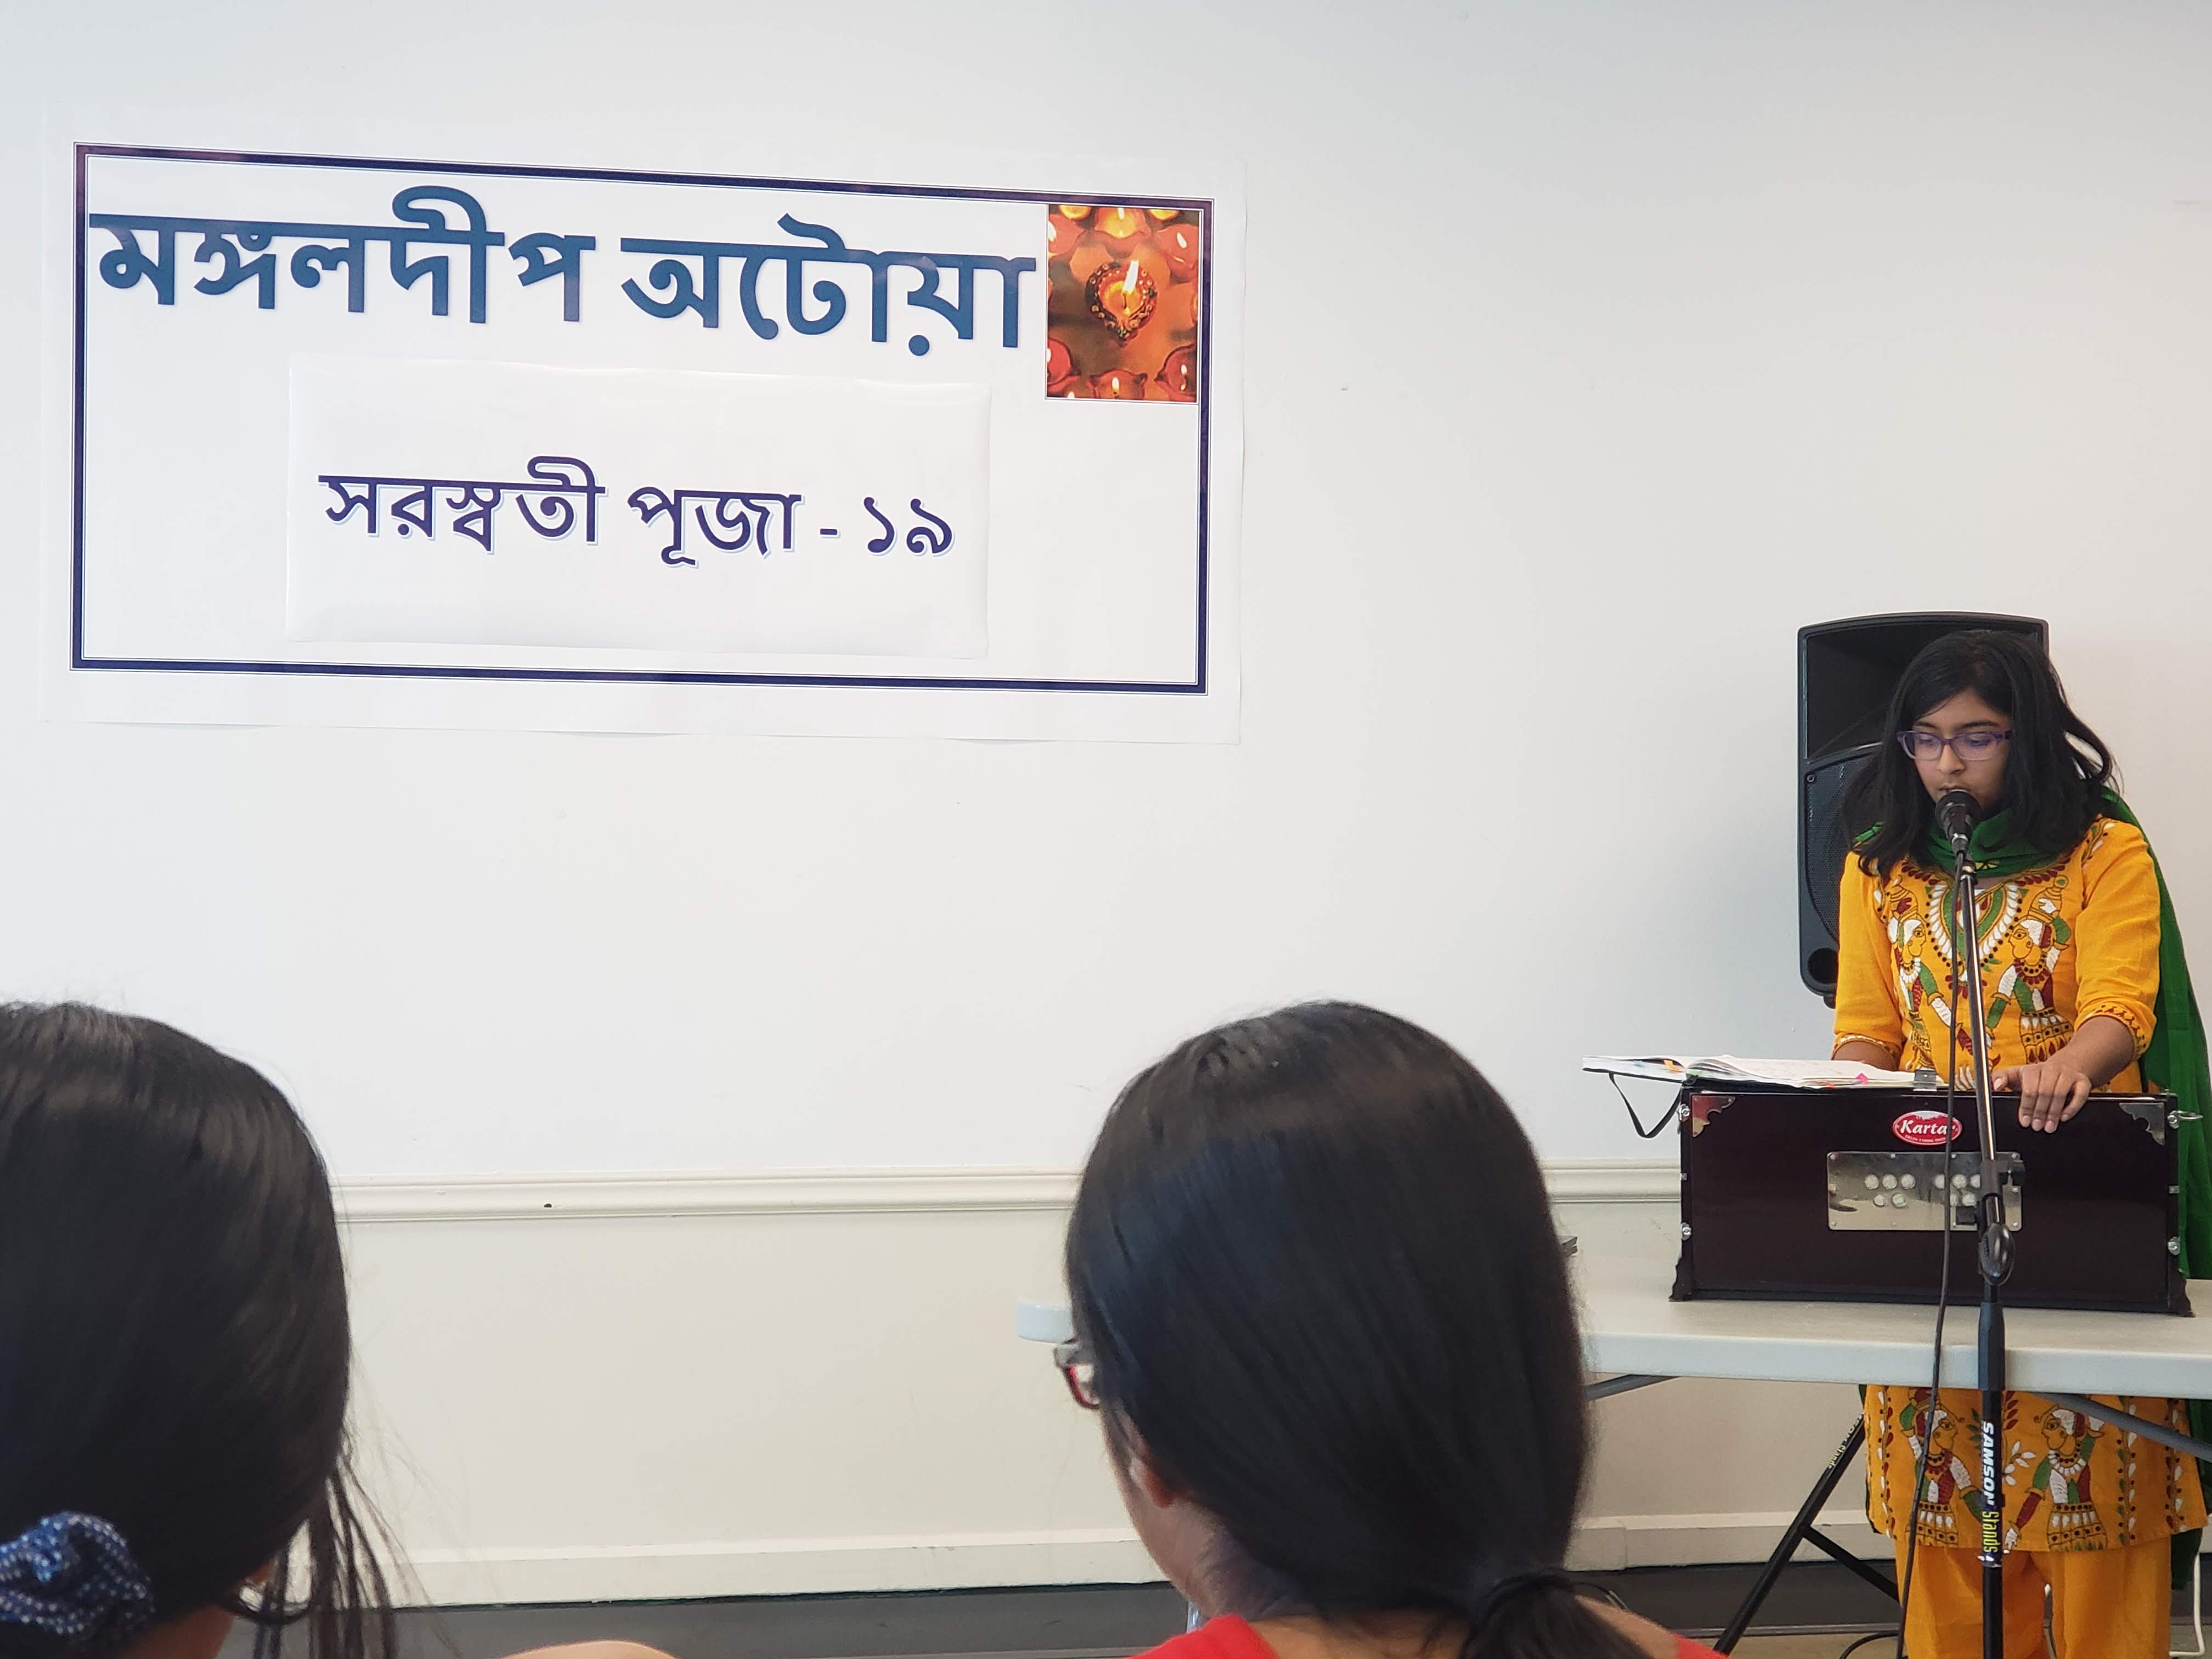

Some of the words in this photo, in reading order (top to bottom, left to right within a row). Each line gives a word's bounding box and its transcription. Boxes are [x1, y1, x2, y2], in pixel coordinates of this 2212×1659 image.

[89, 186, 596, 324] মঙ্গলদীপ
[621, 213, 1036, 357] অটোয়া
[318, 456, 606, 552] সরস্বতী
[627, 487, 802, 566] পূজা
[864, 496, 953, 554] ১৯
[1983, 1421, 1995, 1506] SAMSON
[1982, 1511, 2001, 1553] Stands
